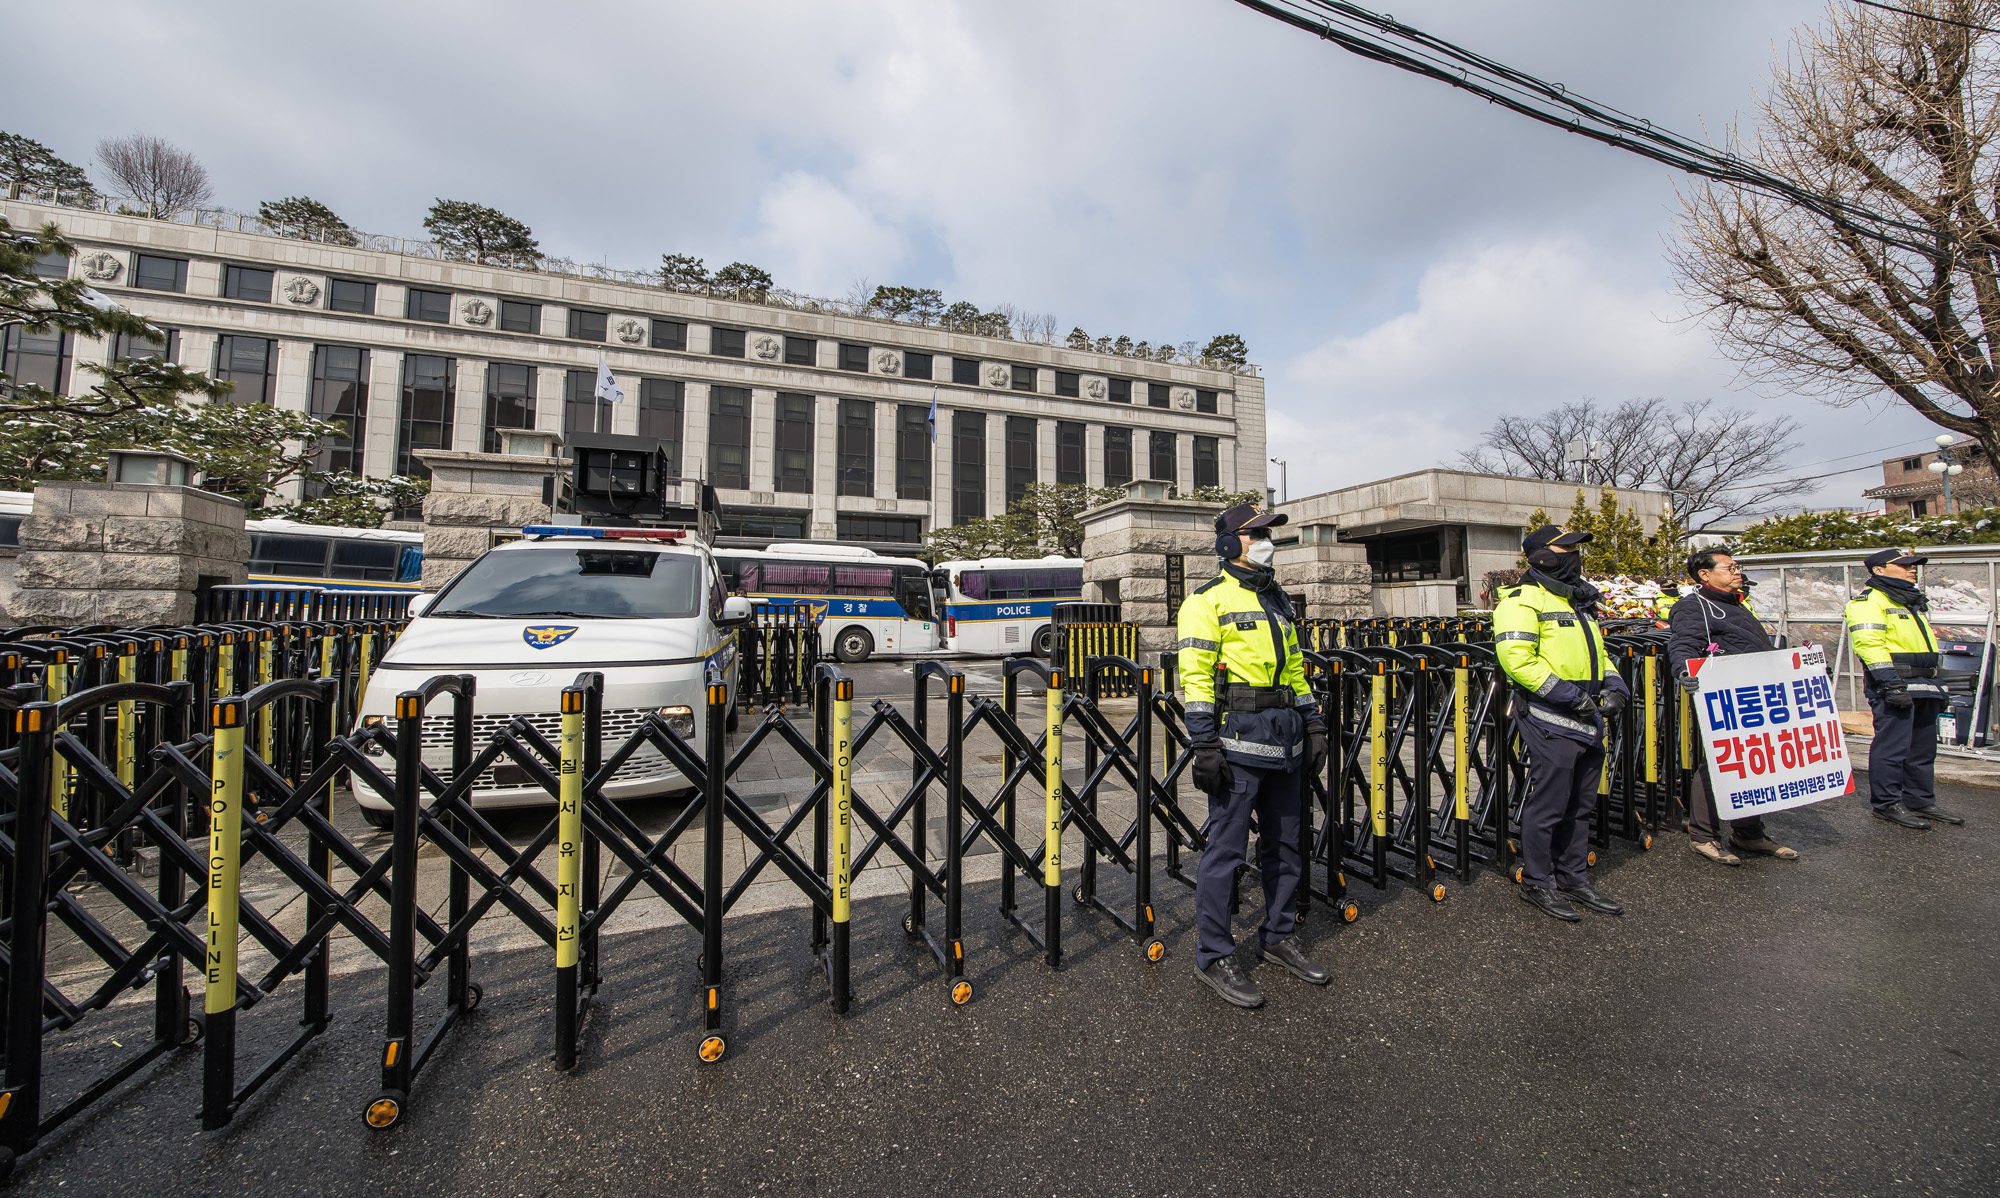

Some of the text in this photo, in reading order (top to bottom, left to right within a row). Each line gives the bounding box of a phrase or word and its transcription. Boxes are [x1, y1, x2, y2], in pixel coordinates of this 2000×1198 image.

[843, 603, 868, 613] 경찰
[997, 606, 1031, 616] POLICE
[1802, 652, 1825, 666] 국민의힘
[1704, 675, 1834, 731] 대통령 탄핵
[1713, 720, 1842, 779] 각하 하라!!
[1730, 770, 1845, 809] 탄핵반대 당협위원장 모임
[838, 740, 849, 899] POLICE LINE
[558, 759, 577, 941] 질서유지선
[208, 779, 227, 984] POLICE LINE
